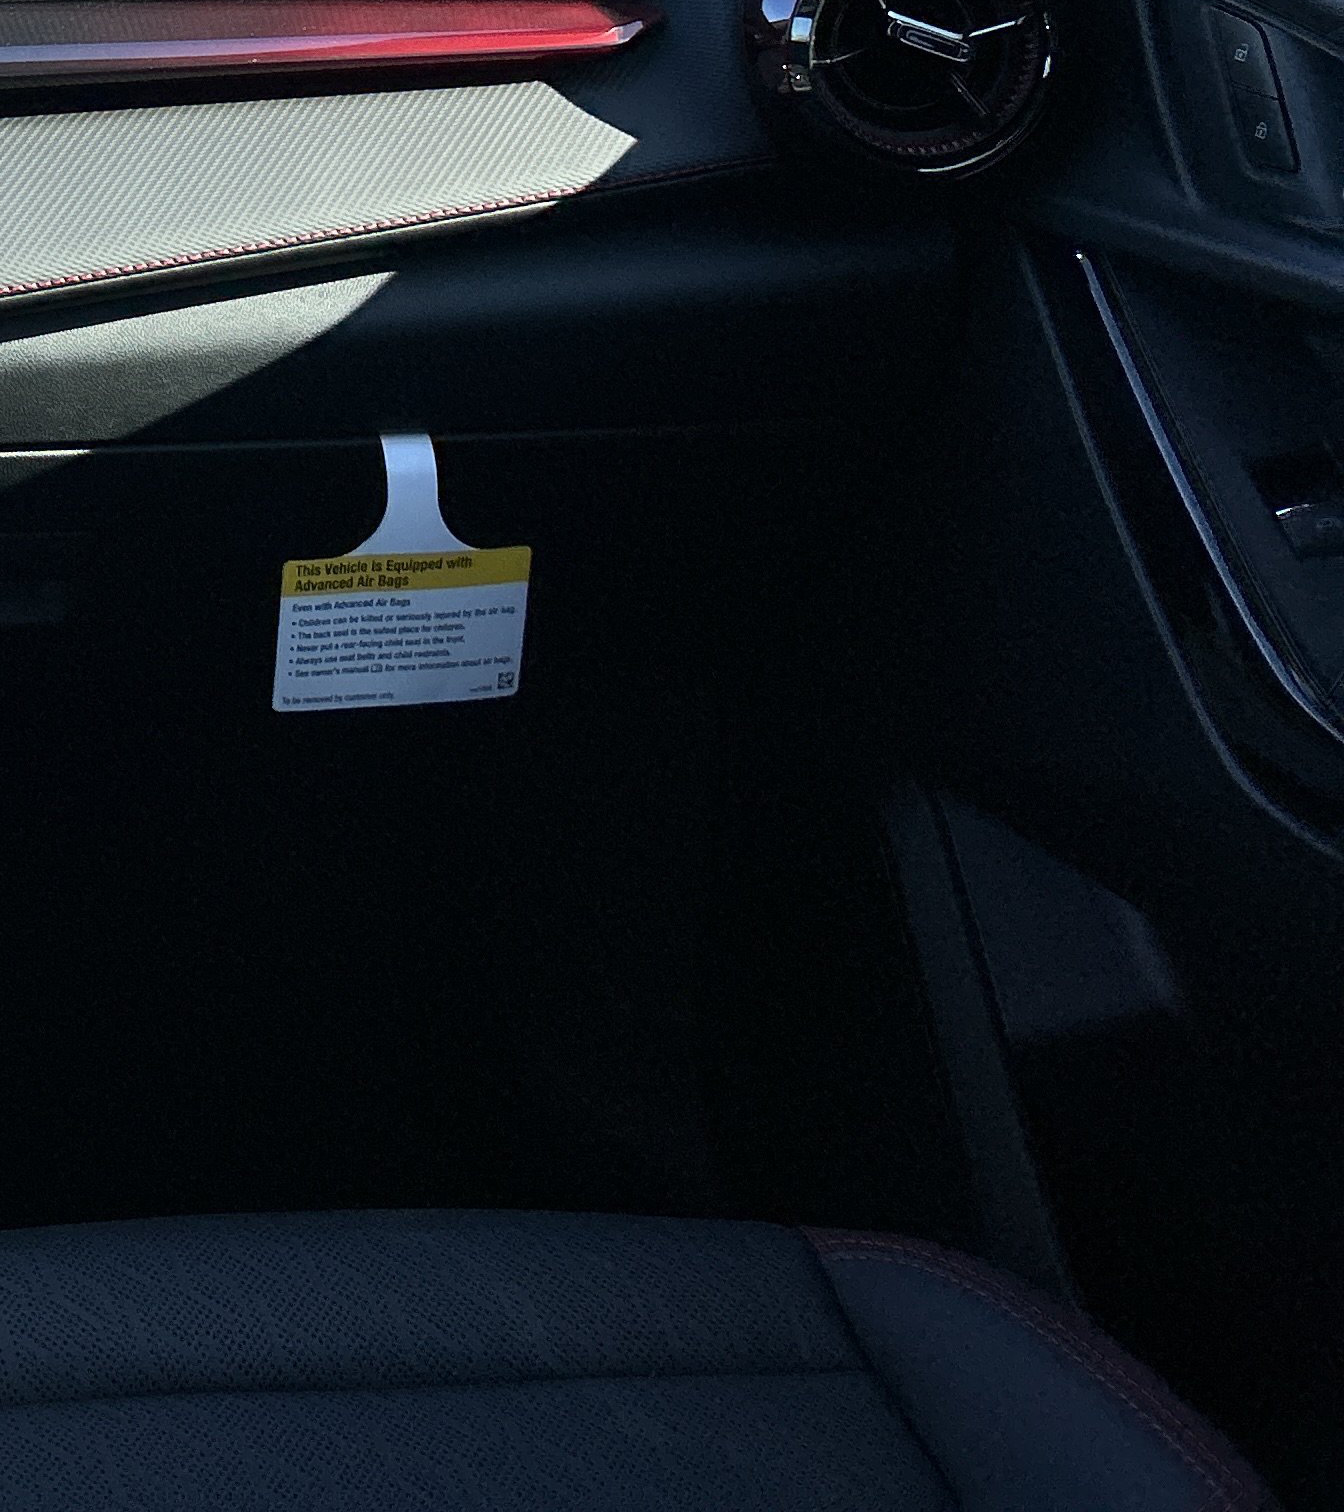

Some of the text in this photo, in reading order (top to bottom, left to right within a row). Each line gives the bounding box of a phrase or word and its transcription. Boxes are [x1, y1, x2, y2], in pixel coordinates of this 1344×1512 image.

[296, 563, 321, 576] This
[325, 561, 368, 575] Vehicle
[386, 558, 443, 574] Equipped
[446, 556, 473, 569] with
[294, 574, 409, 592] Advanced Air Bags
[292, 597, 411, 613] Even with Advanced Air Bags
[298, 617, 330, 628] Children
[332, 616, 347, 625] can
[349, 615, 359, 624] be
[361, 613, 383, 623] killed
[385, 613, 394, 622] or
[396, 610, 432, 622] seriously
[433, 608, 461, 620] injured
[463, 607, 473, 619] by
[298, 630, 311, 640] The
[313, 629, 330, 639] back
[359, 627, 371, 636] the
[373, 625, 397, 635] safest
[398, 624, 419, 636] place
[420, 623, 432, 633] for
[296, 644, 318, 653] Never
[320, 642, 333, 653] put
[341, 639, 383, 651] rear-facing
[384, 637, 403, 648] child
[295, 655, 322, 666] Always
[377, 651, 392, 661] and
[394, 650, 412, 660] child
[341, 664, 369, 674] manual
[303, 694, 333, 704] removed
